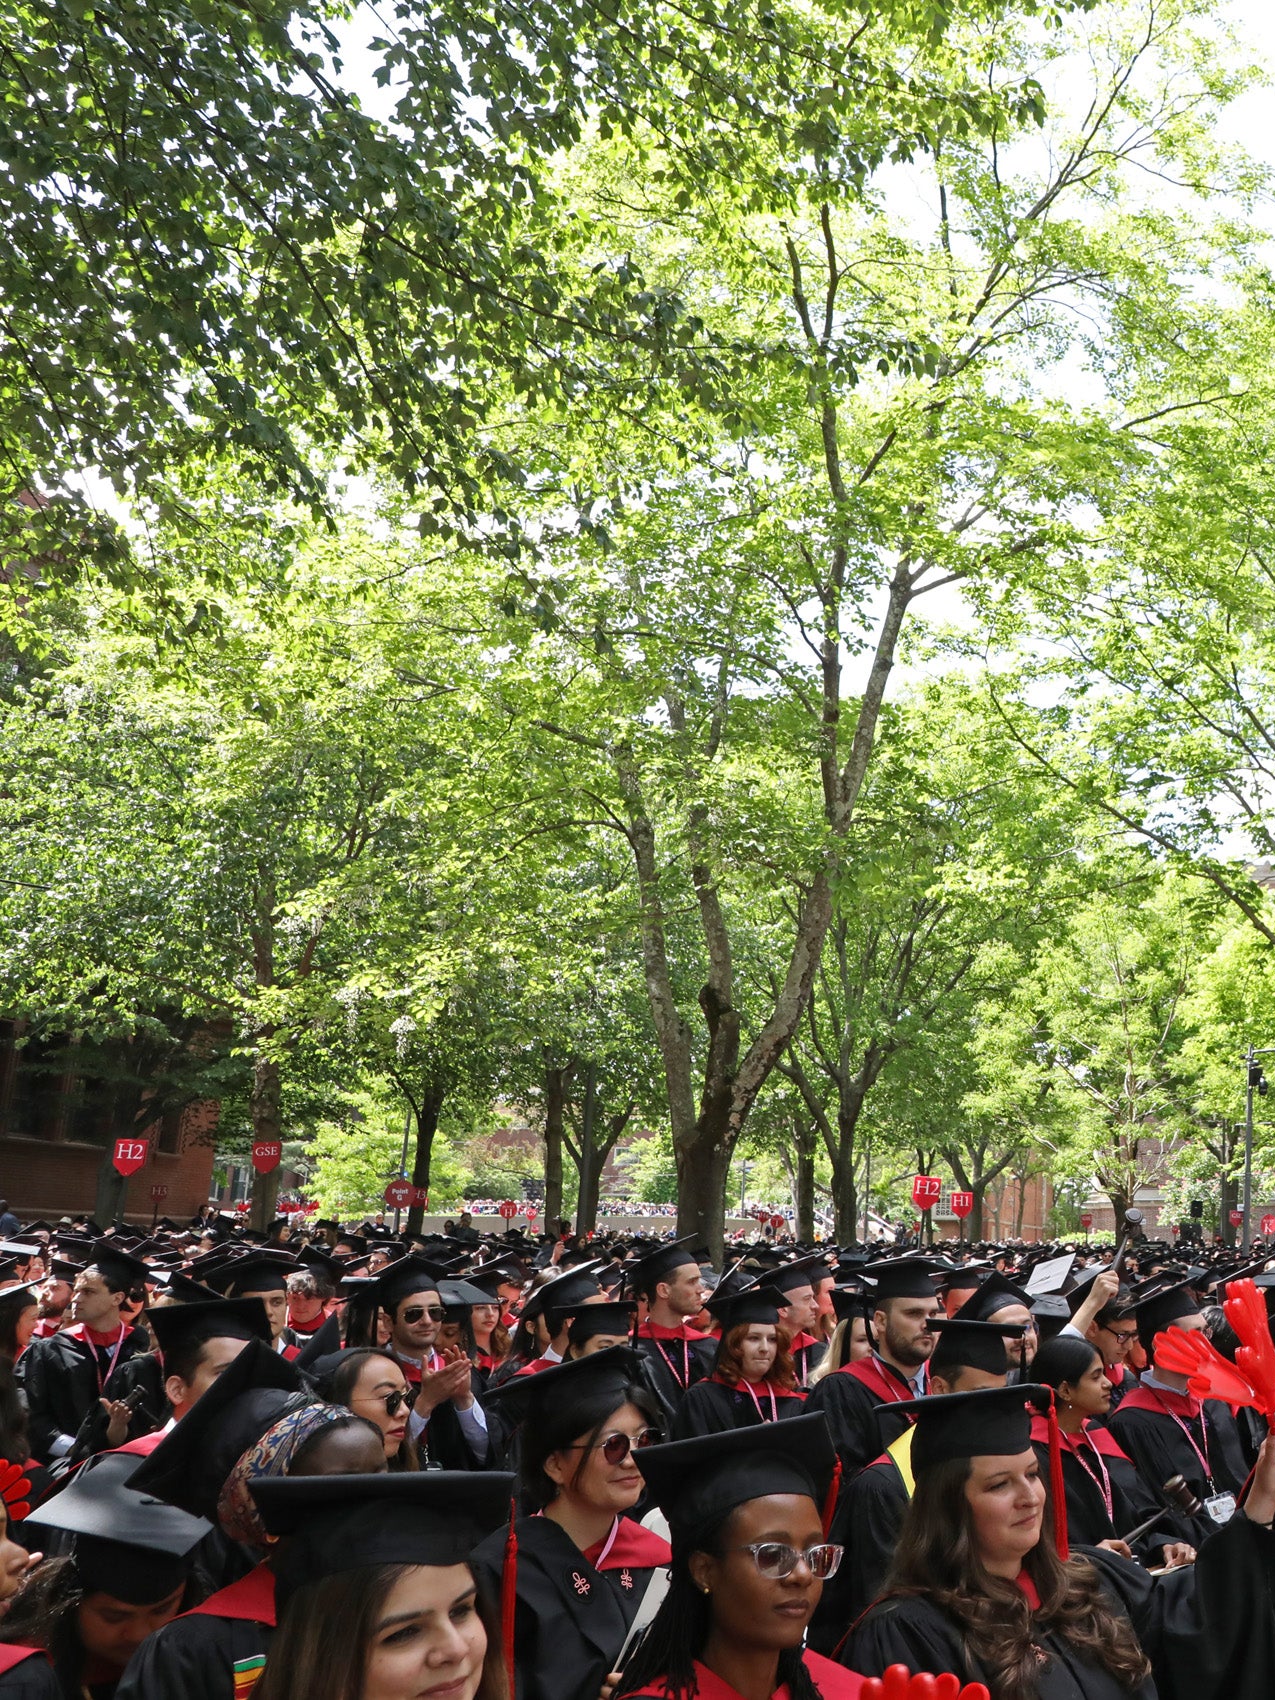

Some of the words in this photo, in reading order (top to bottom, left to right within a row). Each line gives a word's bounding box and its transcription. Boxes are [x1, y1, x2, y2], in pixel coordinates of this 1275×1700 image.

[116, 1143, 144, 1160] H2
[255, 1146, 279, 1157] GSE
[915, 1180, 940, 1196] H2
[953, 1195, 969, 1207] H1
[1264, 1223, 1273, 1233] K
